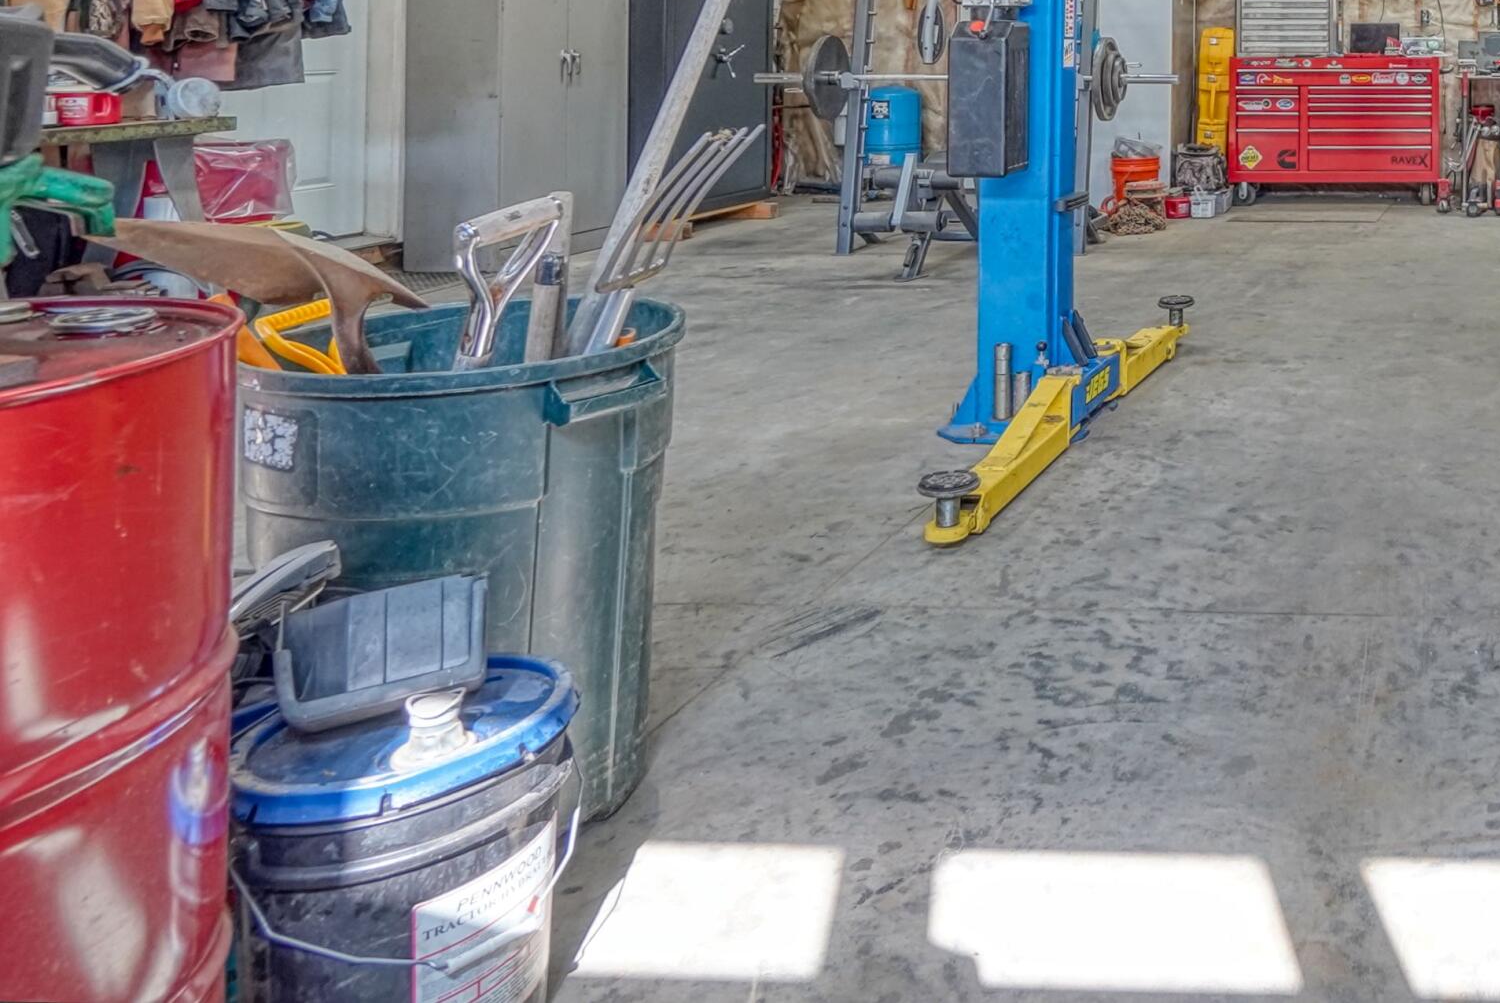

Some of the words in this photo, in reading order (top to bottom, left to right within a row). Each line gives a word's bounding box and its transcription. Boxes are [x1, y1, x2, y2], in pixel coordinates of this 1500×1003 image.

[1085, 366, 1110, 404] JEGS
[456, 845, 543, 913] PENNWOOD
[421, 894, 497, 941] TRACTOR
